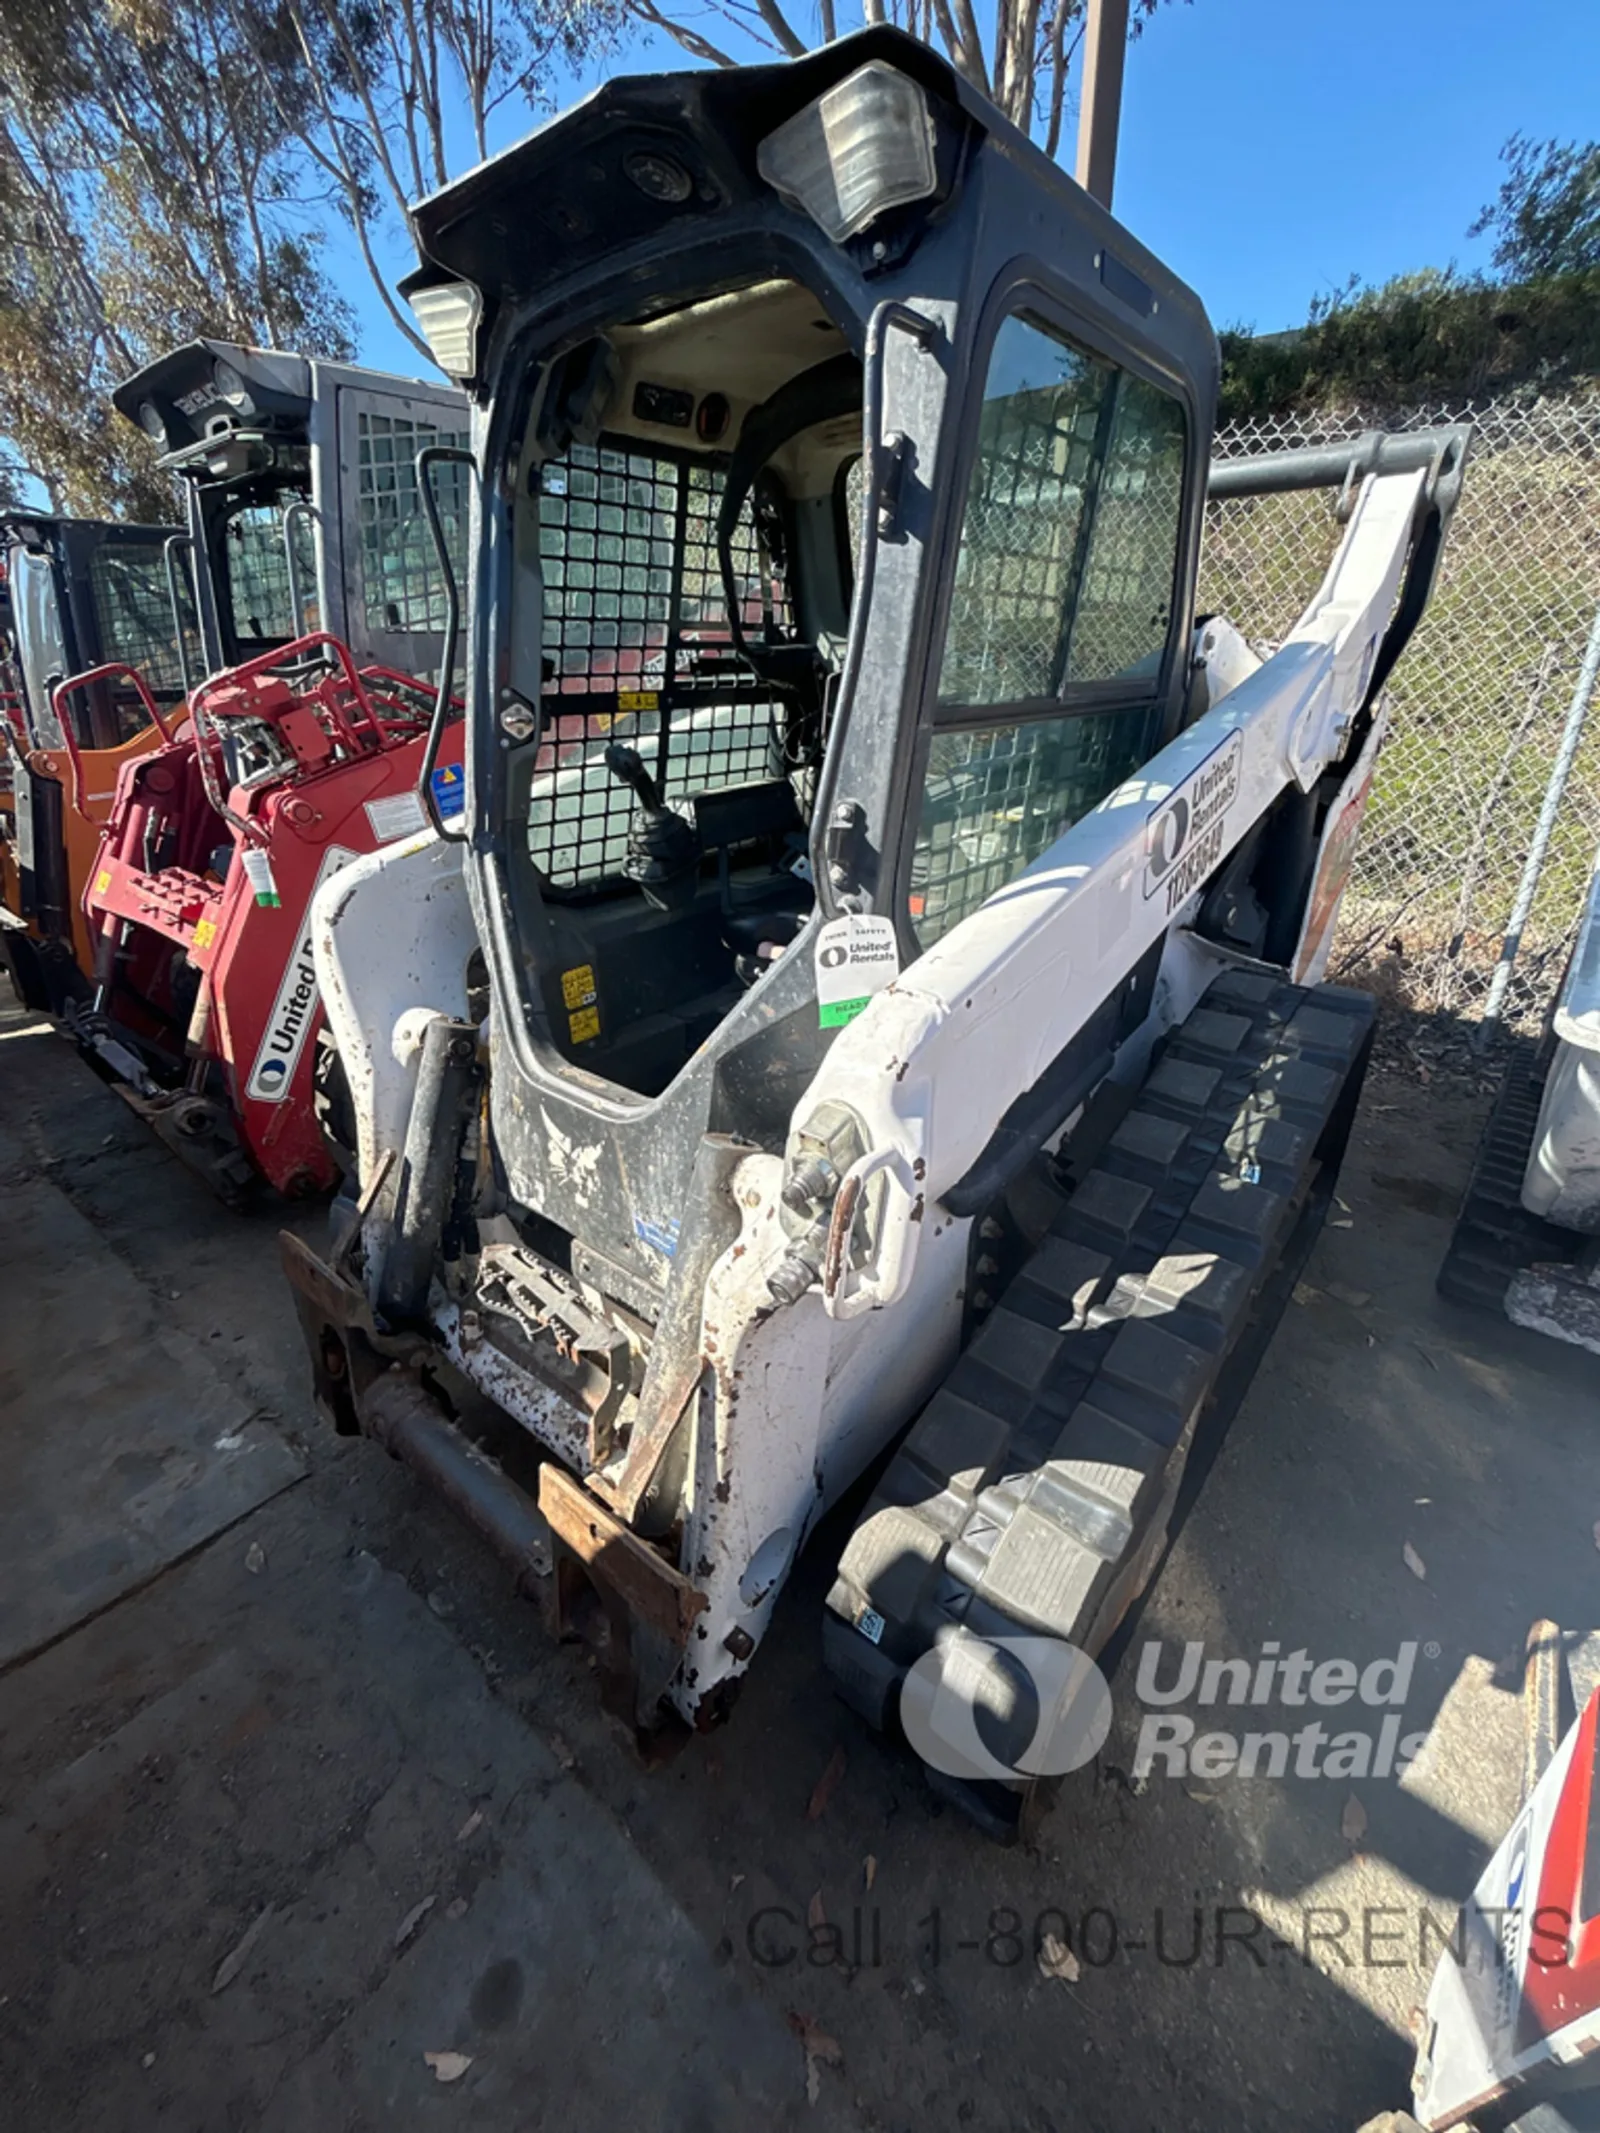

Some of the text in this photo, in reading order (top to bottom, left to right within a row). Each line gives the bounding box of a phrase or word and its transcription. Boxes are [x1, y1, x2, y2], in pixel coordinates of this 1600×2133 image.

[850, 941, 892, 953] United
[850, 952, 896, 964] Rentals
[270, 963, 315, 1054] United
